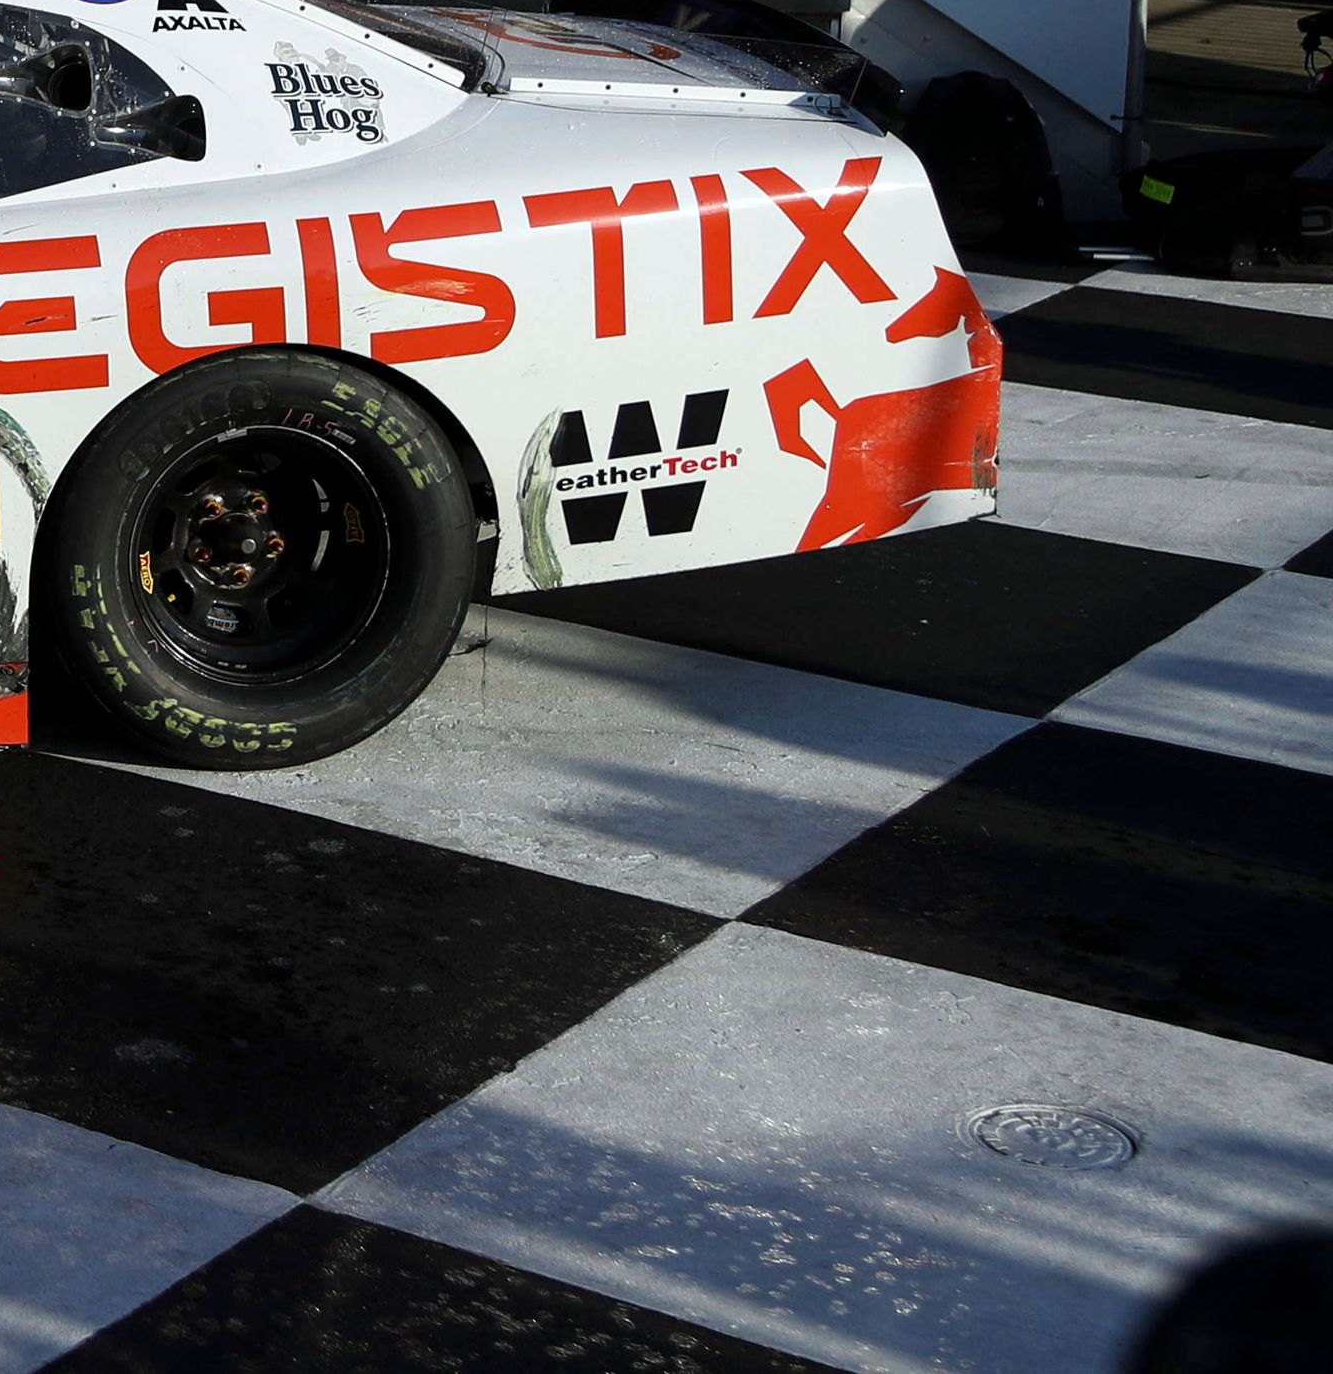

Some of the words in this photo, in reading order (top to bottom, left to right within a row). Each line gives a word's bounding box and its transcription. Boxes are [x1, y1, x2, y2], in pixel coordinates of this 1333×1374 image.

[152, 16, 247, 32] AXALTA
[264, 62, 382, 99] Blues
[288, 97, 382, 144] Hog
